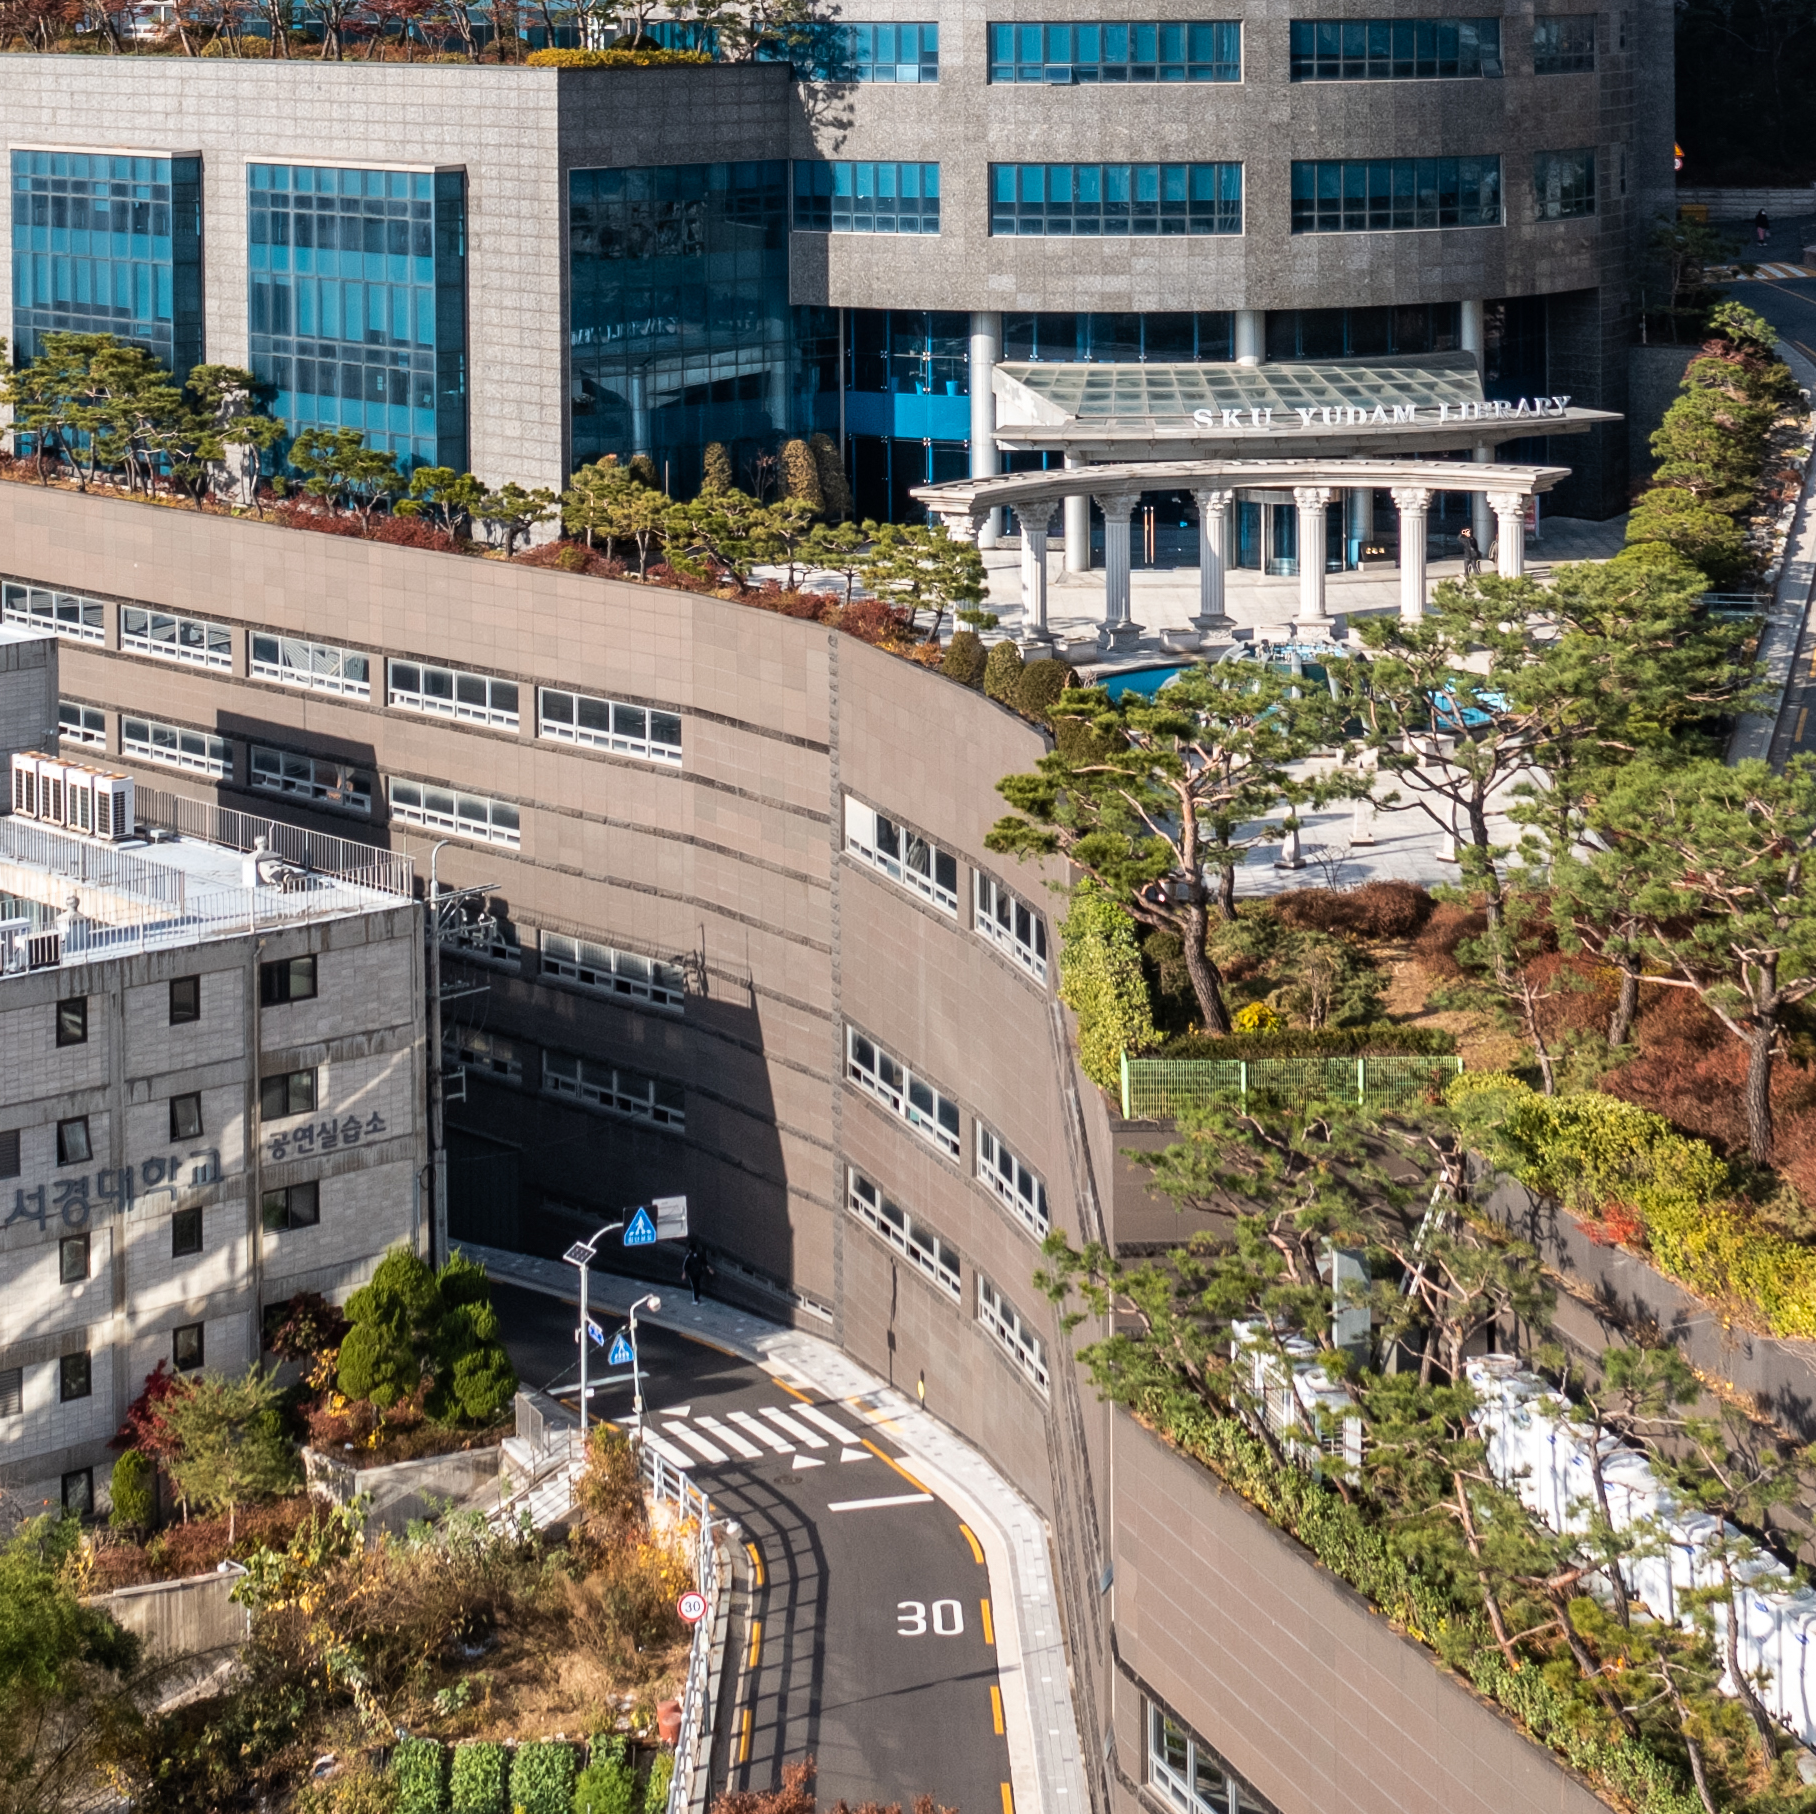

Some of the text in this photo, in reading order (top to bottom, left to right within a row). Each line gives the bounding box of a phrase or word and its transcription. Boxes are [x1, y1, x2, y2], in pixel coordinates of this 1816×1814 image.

[1193, 395, 1572, 429] SKU YUDAM LIBRARY
[267, 1111, 387, 1161] 공연실습소
[4, 1147, 225, 1232] 서경대학교
[685, 1601, 700, 1612] 30
[897, 1599, 964, 1636] 30
